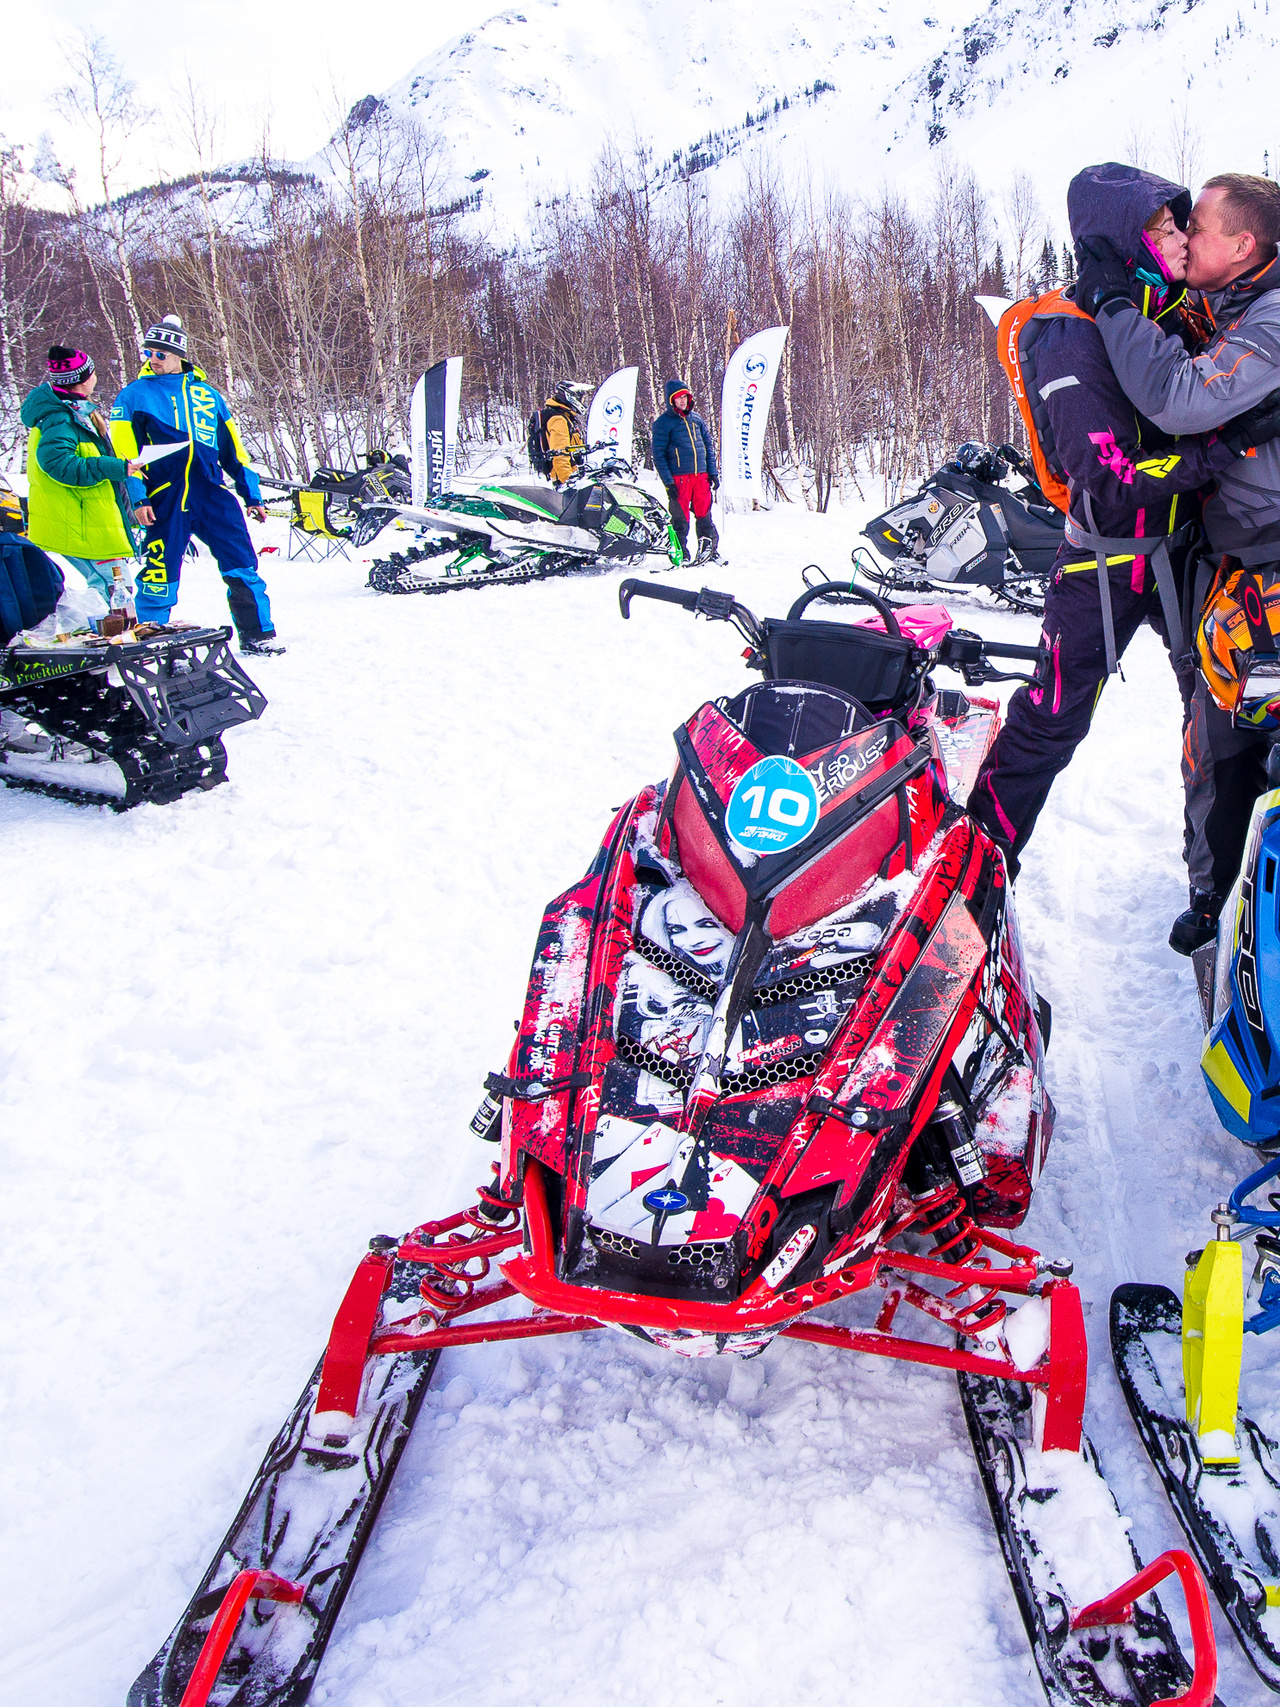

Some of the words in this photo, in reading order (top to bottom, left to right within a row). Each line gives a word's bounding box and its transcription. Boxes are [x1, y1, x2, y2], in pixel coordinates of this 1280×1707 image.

[1007, 316, 1024, 398] FLOAT
[190, 385, 216, 430] FXR
[930, 502, 964, 546] PRO
[16, 661, 74, 684] FreeRider
[816, 734, 888, 803] ERIOUS?
[828, 754, 850, 773] SO
[740, 785, 810, 828] 10
[776, 945, 837, 972] AVTOGRAF
[547, 1022, 563, 1056] QUITE
[760, 1040, 802, 1063] QUINN
